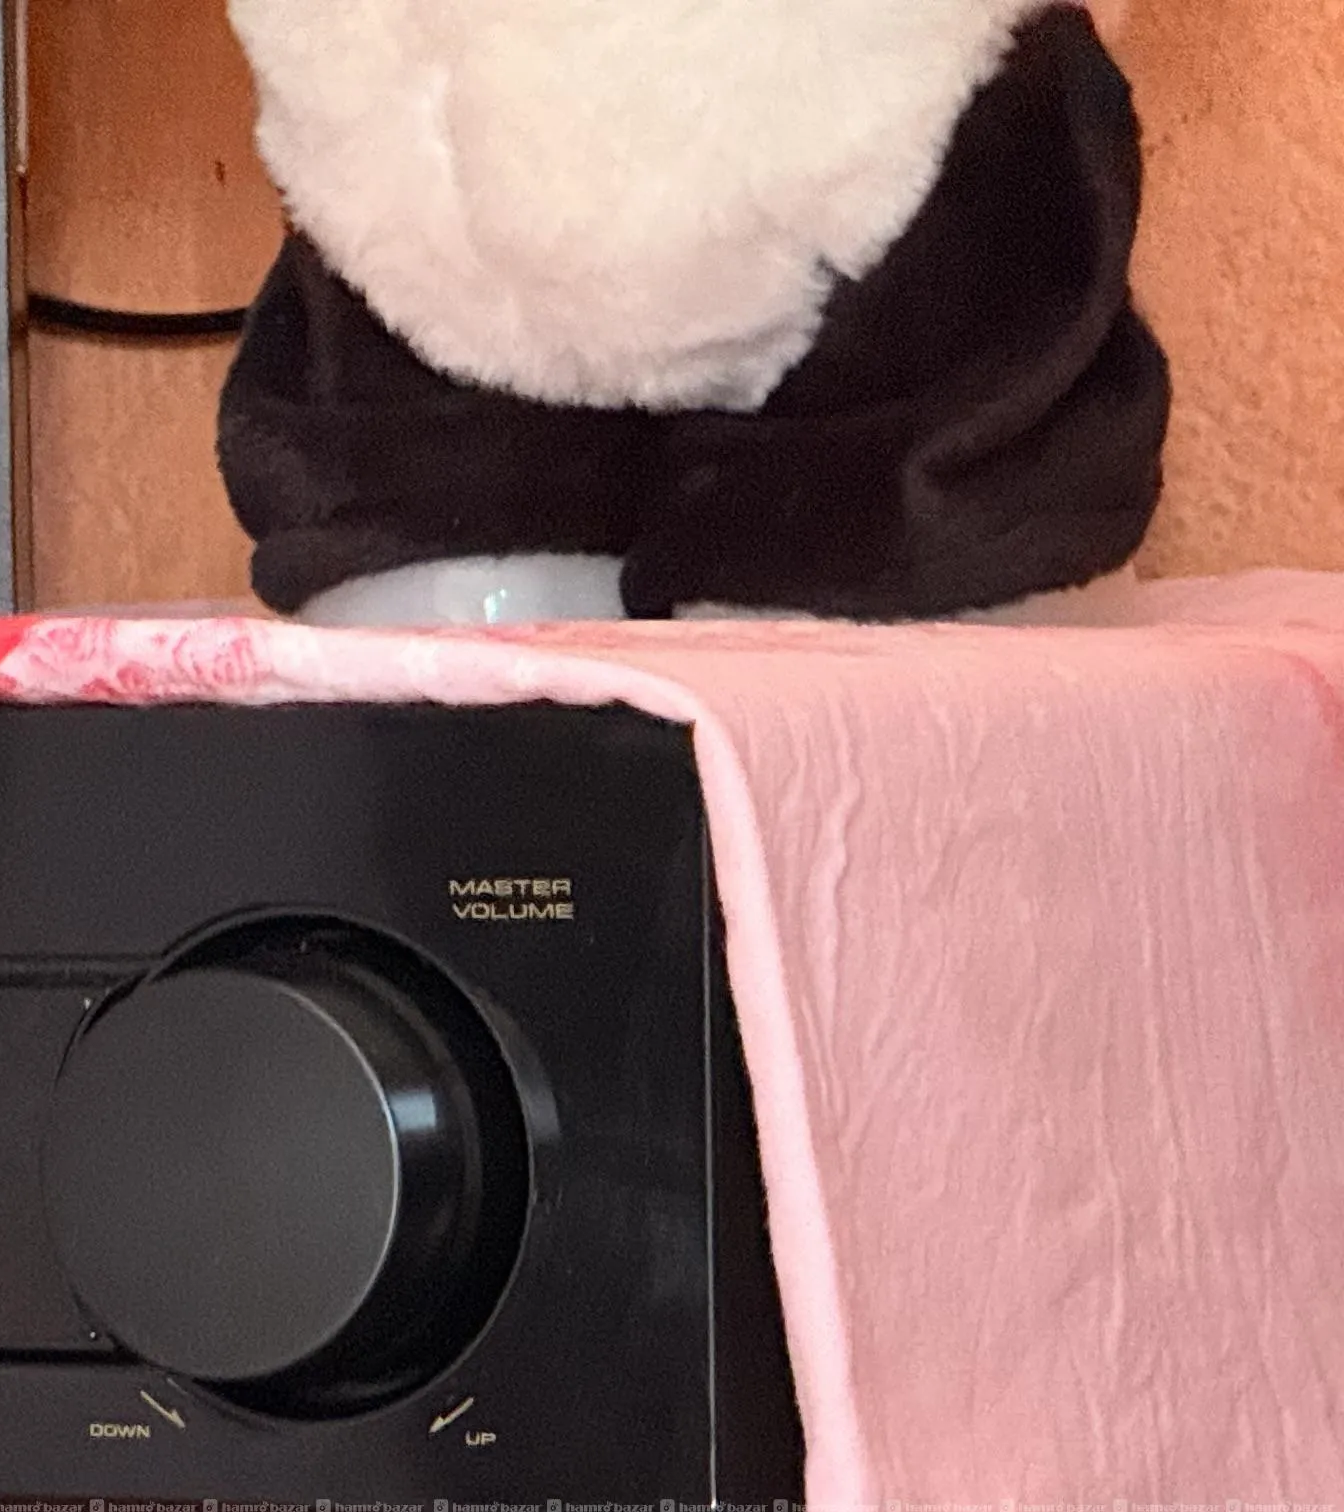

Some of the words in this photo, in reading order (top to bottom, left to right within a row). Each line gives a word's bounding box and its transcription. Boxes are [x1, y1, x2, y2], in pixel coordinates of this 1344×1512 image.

[449, 878, 571, 897] MASTER
[452, 902, 574, 921] VOLUME
[89, 1423, 151, 1438] DOWN
[465, 1431, 497, 1446] UP
